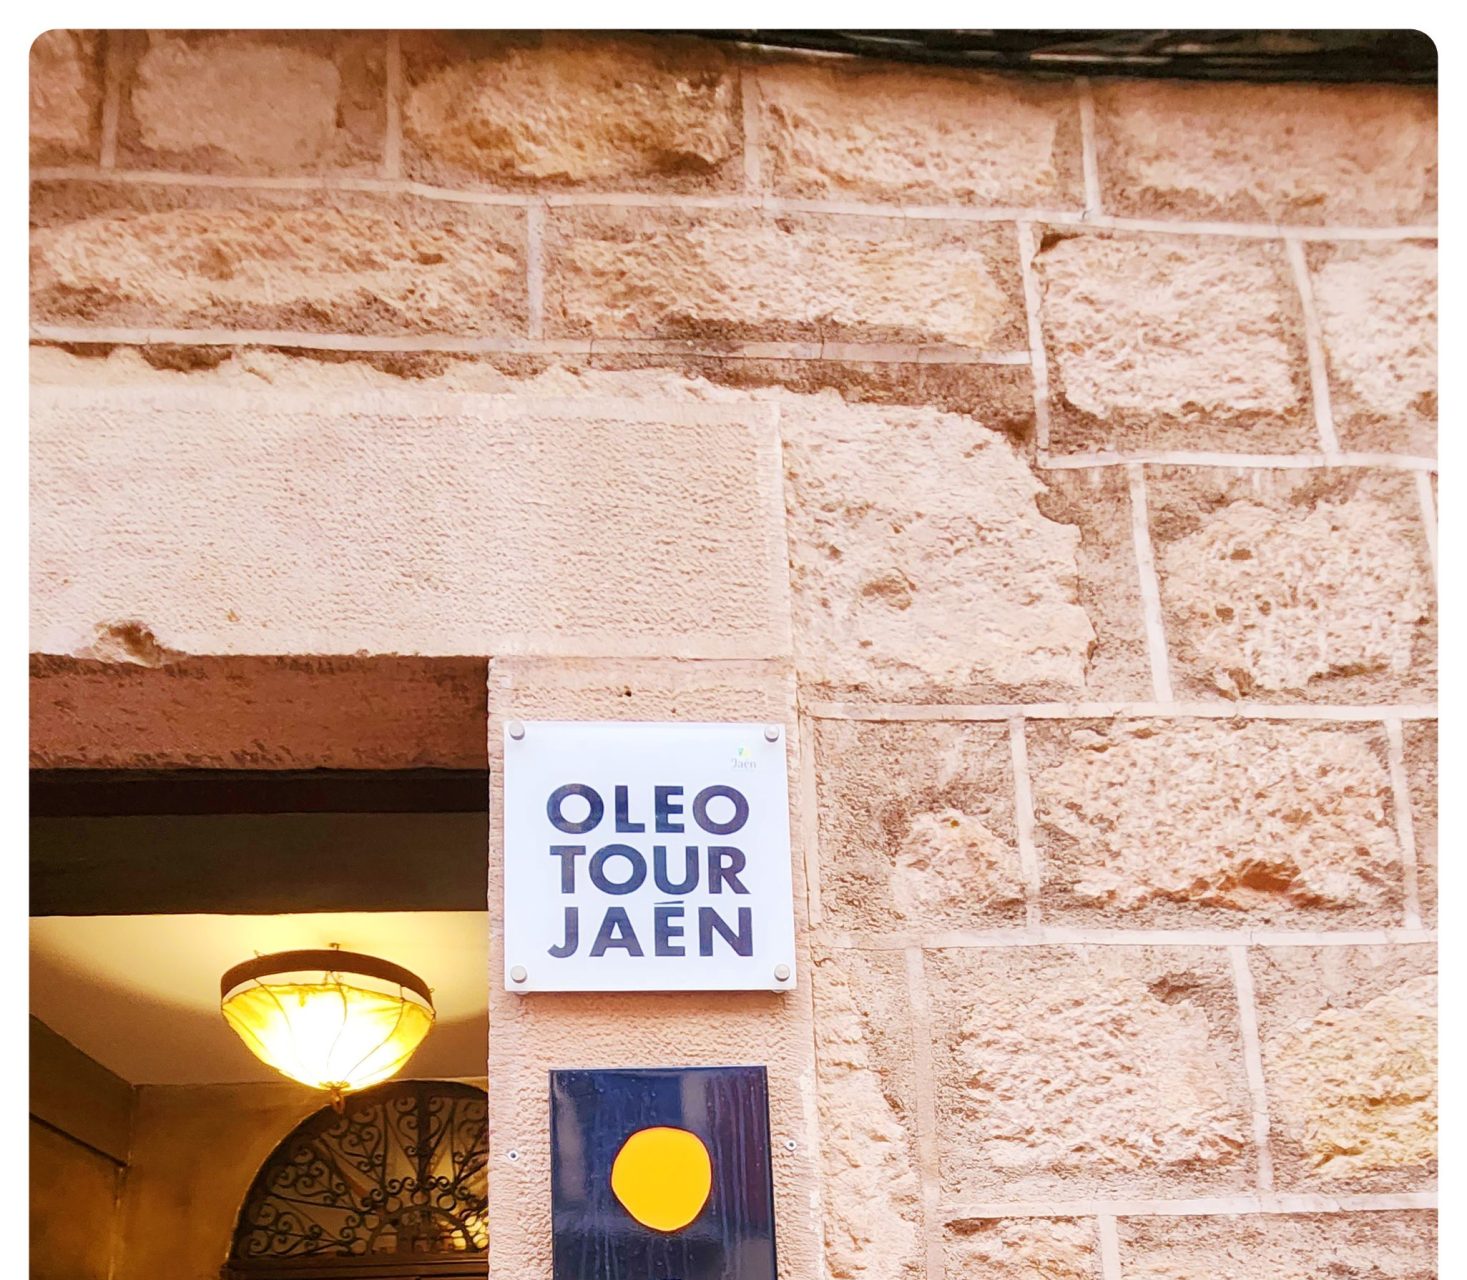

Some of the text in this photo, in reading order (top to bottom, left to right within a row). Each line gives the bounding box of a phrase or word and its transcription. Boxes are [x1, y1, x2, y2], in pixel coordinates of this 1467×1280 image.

[546, 783, 749, 835] OLEO
[549, 843, 751, 895] TOUR
[547, 900, 753, 958] JAÉN
